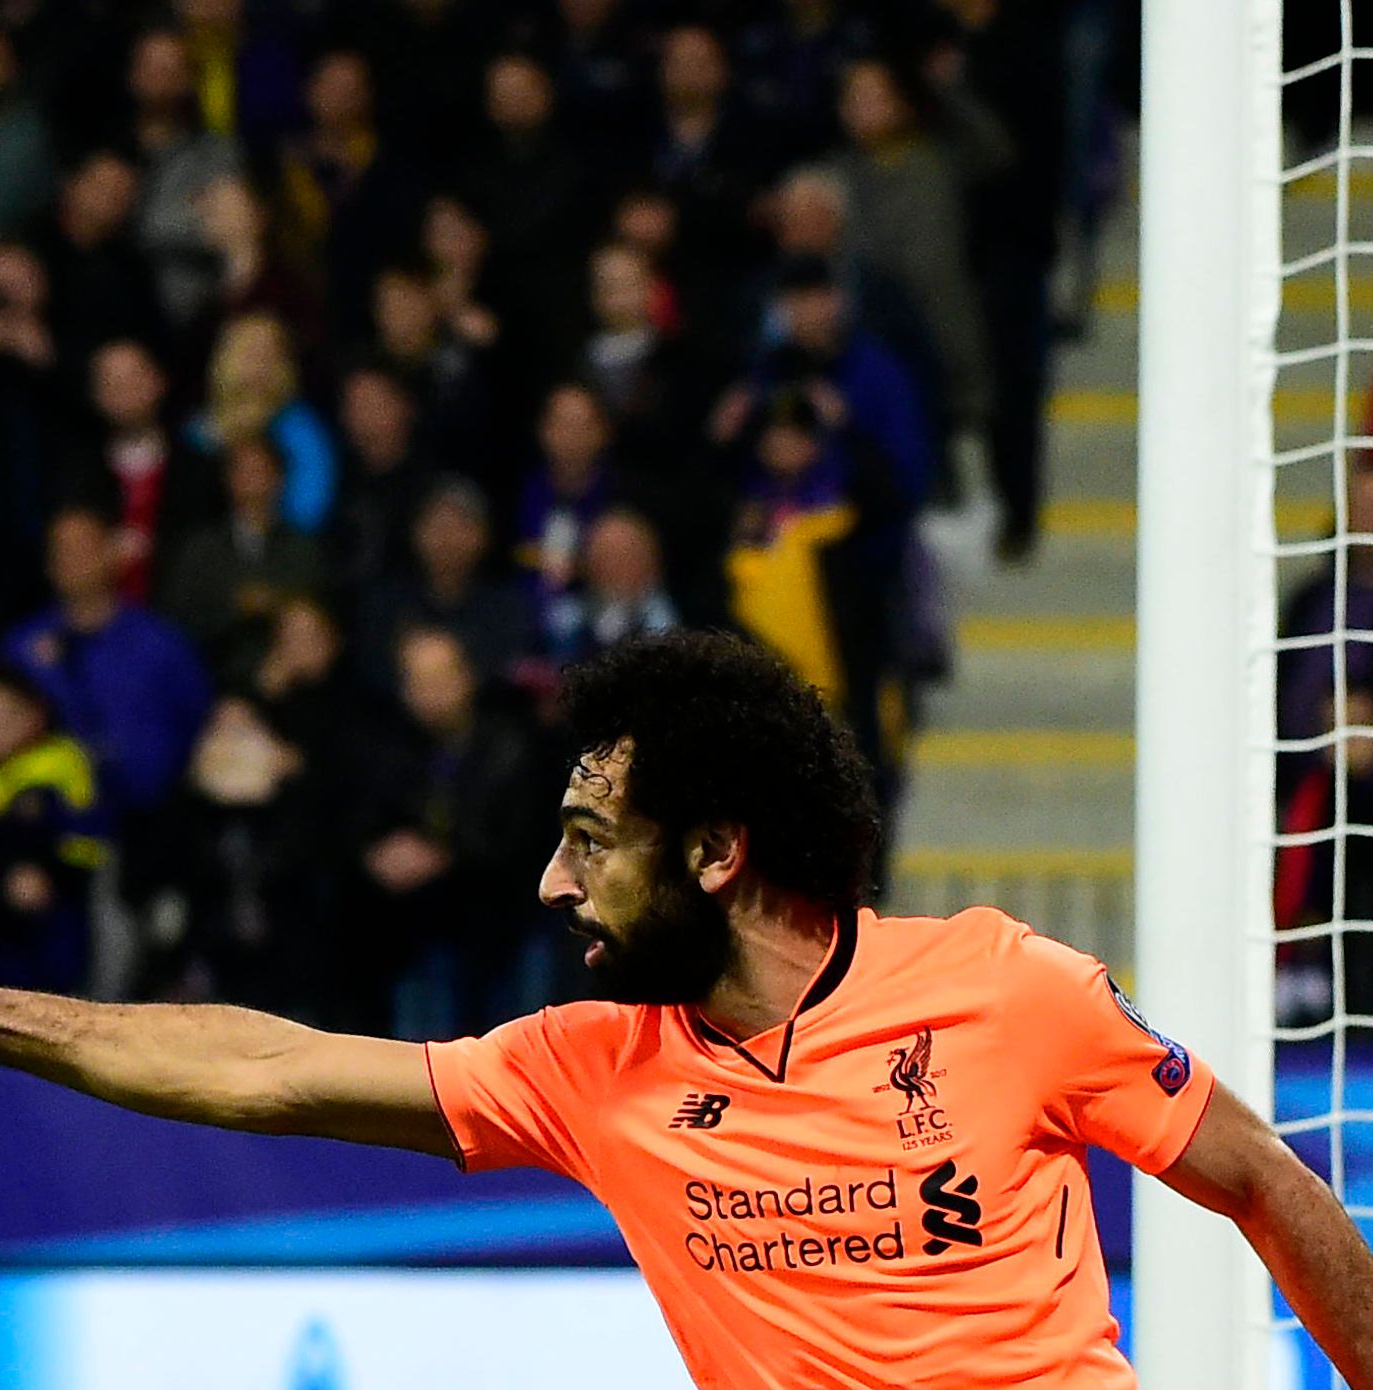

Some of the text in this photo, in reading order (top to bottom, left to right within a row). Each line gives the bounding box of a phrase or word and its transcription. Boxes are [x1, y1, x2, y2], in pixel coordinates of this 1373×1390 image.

[919, 1130, 953, 1147] YEARS
[685, 1169, 897, 1220] Standard
[685, 1222, 904, 1272] Chartered
